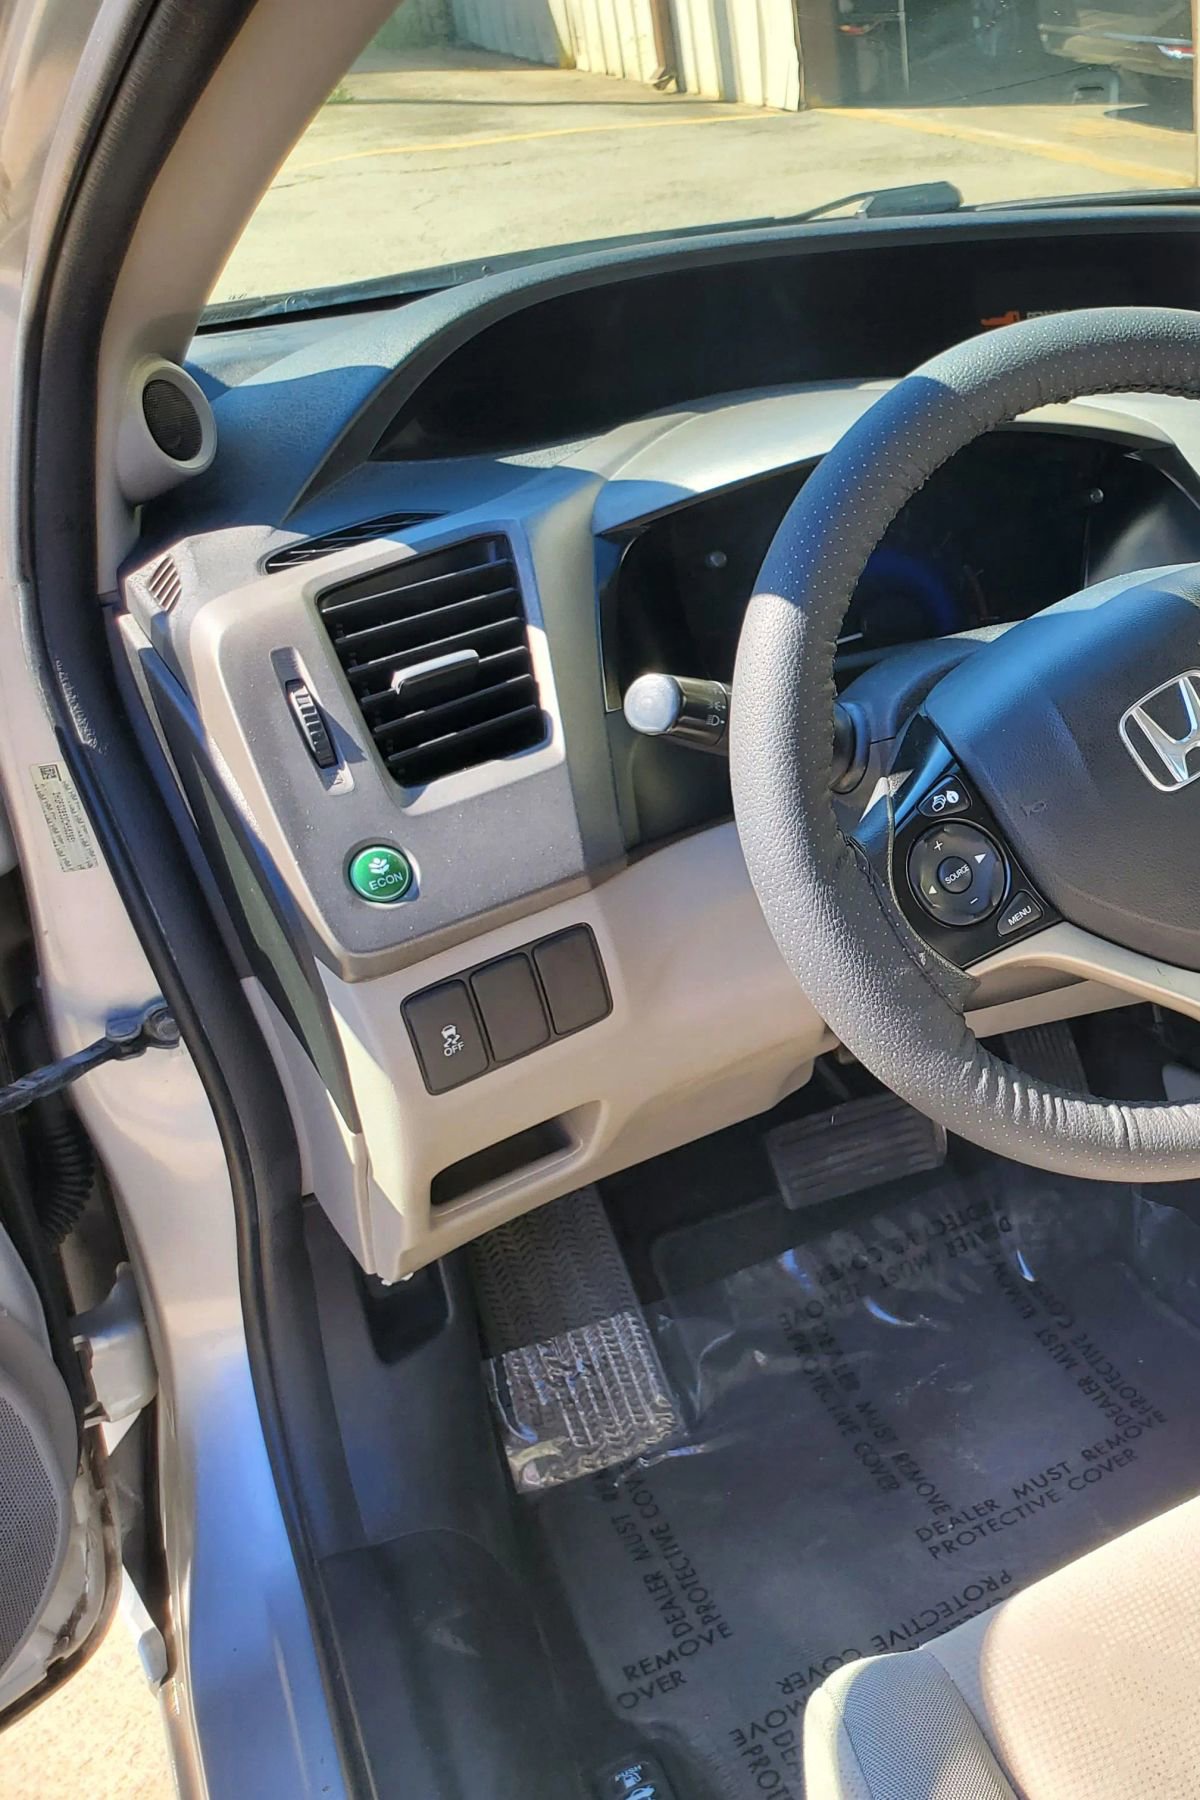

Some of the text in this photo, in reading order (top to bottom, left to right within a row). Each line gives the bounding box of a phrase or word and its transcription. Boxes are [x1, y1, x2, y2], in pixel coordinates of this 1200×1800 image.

[368, 872, 404, 891] ECON
[945, 864, 970, 885] SOURCE
[1008, 905, 1032, 926] MENU
[443, 1041, 465, 1057] OFF
[1034, 1328, 1079, 1371] MUST
[1077, 1376, 1132, 1427] DEALER
[915, 1409, 1168, 1543] DEALER MUST REMOVE
[928, 1448, 1138, 1560] PROTECTIVE COVER
[611, 1513, 694, 1639] DEALER MUST
[650, 1522, 723, 1627] PROTECTIVE
[870, 1569, 1013, 1652] PROTECTIVE
[622, 1621, 734, 1681] REMOVE
[728, 1698, 807, 1749] MOVE
